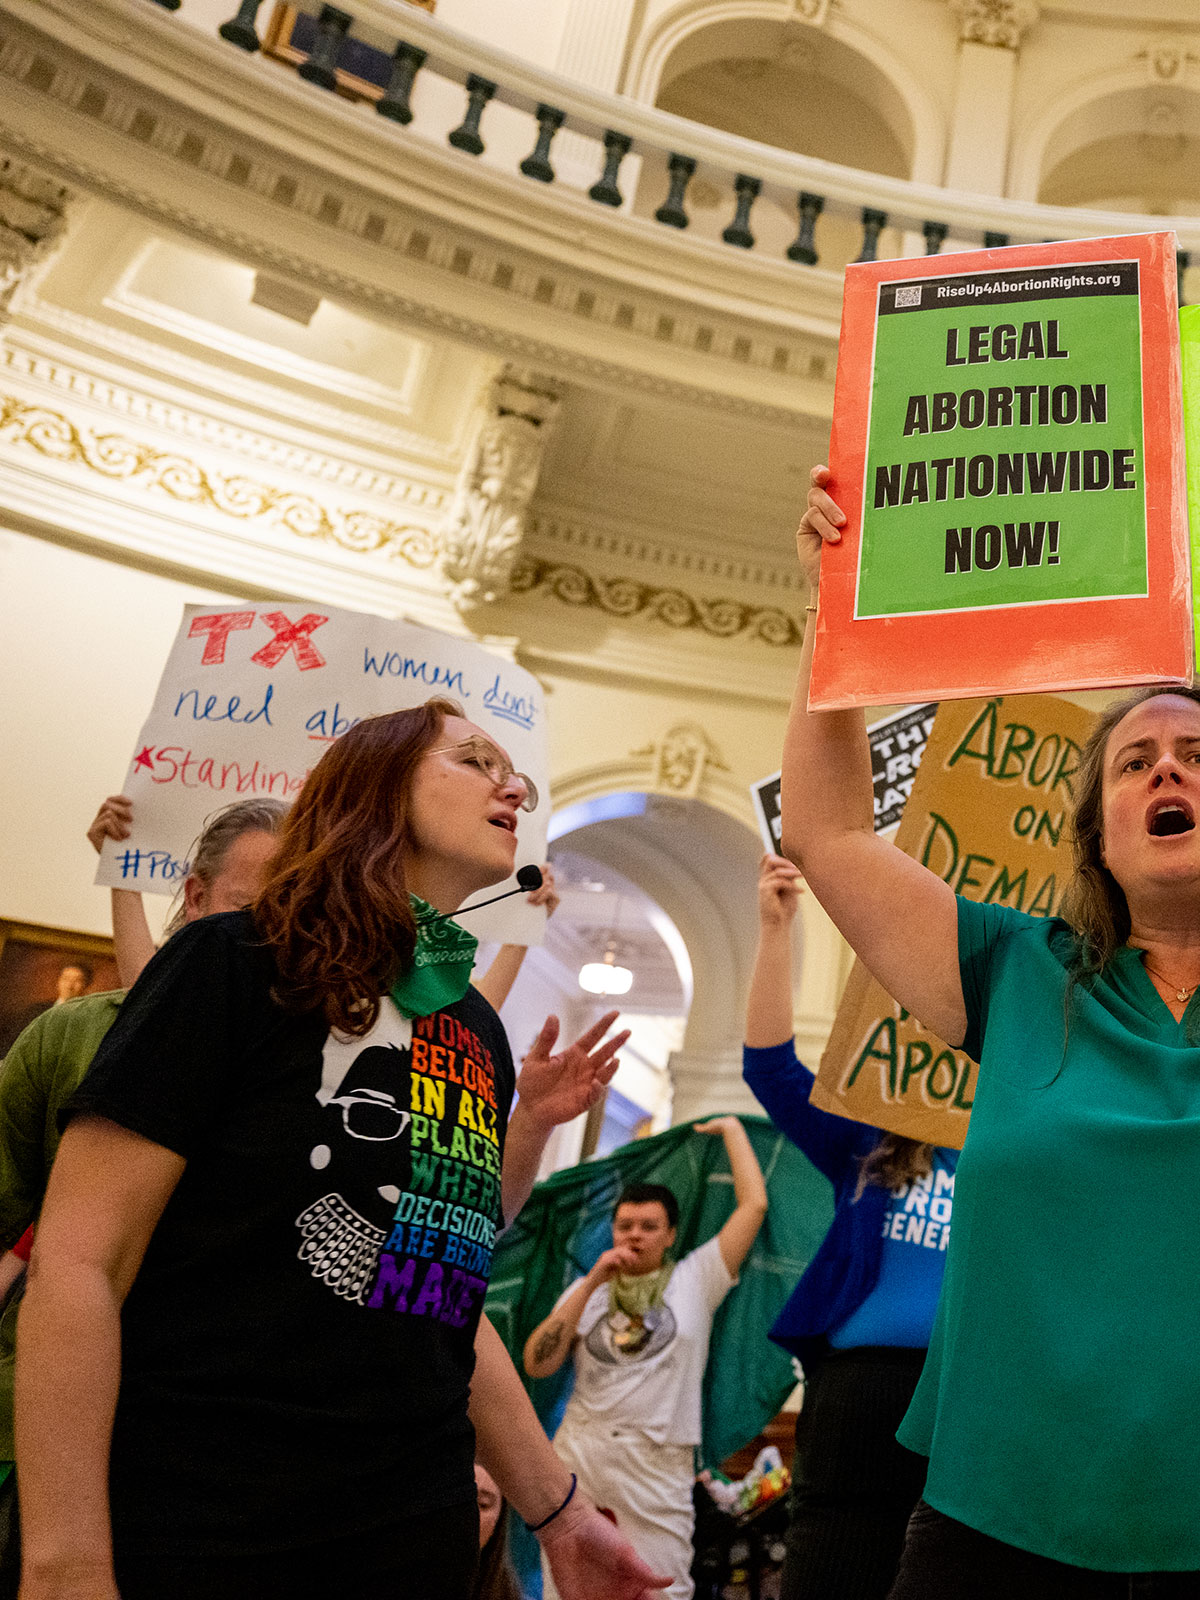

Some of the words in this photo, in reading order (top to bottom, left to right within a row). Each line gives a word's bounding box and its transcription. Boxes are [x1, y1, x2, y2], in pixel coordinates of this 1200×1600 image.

[937, 274, 1121, 298] RiseUp4AbortionRights.org
[946, 320, 1069, 367] LEGAL
[903, 384, 1108, 437] ABORTION
[874, 449, 1137, 509] NATIONWIDE
[945, 520, 1060, 574] NOW!
[188, 611, 329, 671] TX
[174, 684, 273, 726] need
[1014, 804, 1065, 847] ON
[410, 1072, 447, 1120] IN
[383, 1223, 439, 1258] ARE
[392, 1191, 497, 1249] DECISIONS
